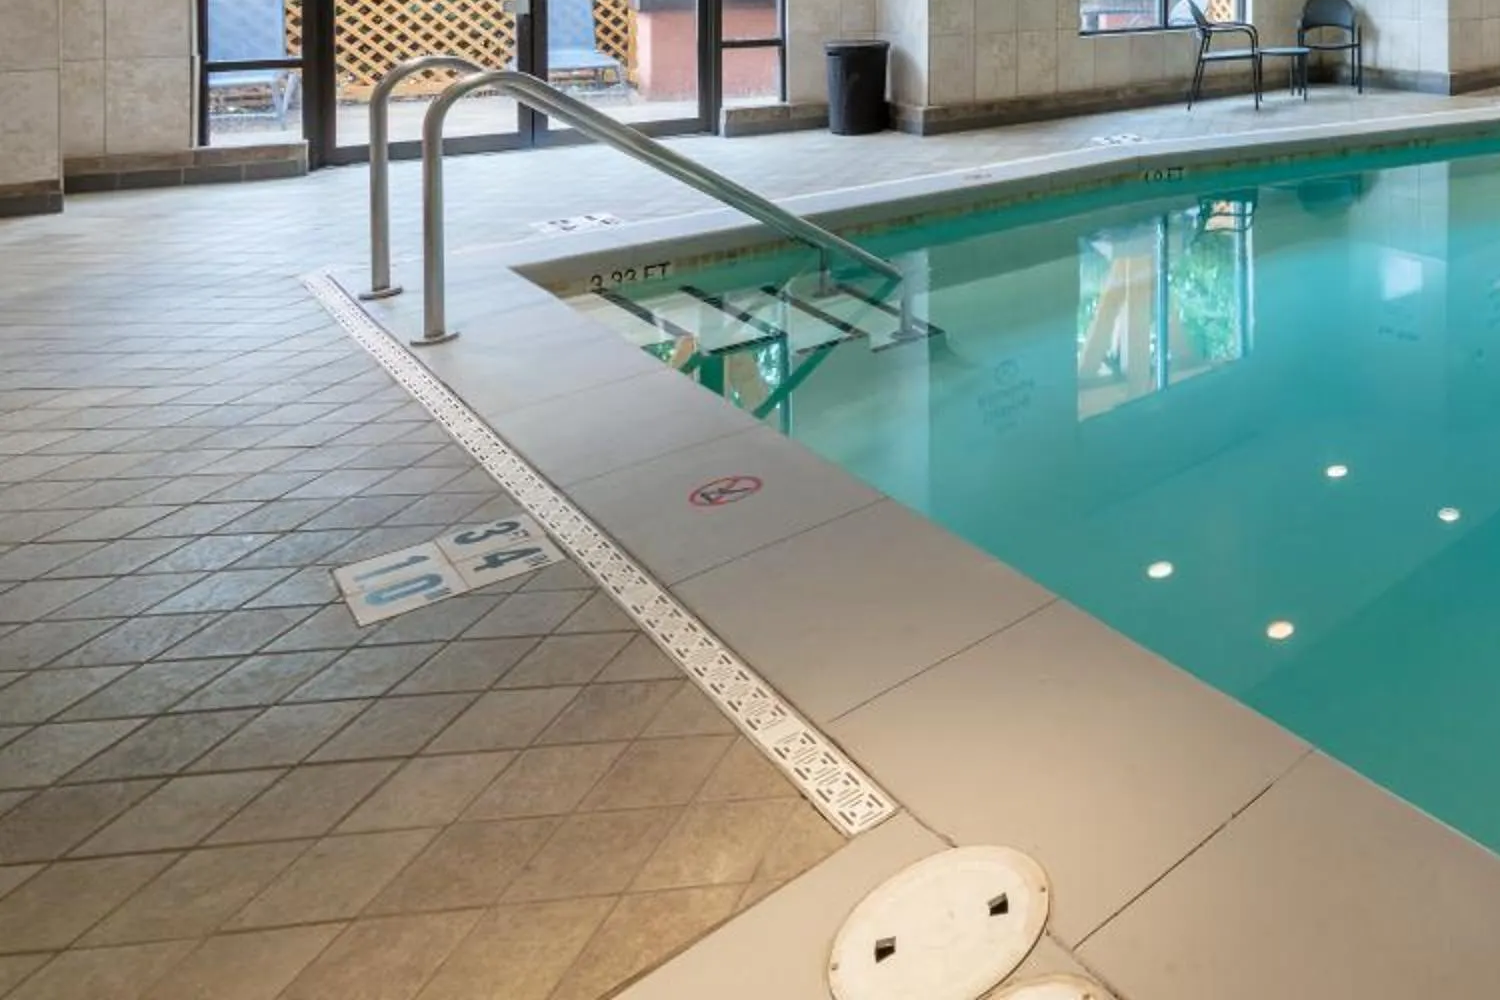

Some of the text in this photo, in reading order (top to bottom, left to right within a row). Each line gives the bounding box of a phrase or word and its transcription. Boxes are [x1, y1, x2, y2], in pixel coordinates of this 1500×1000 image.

[643, 261, 671, 280] FT
[454, 521, 520, 545] 3
[472, 547, 543, 573] 4
